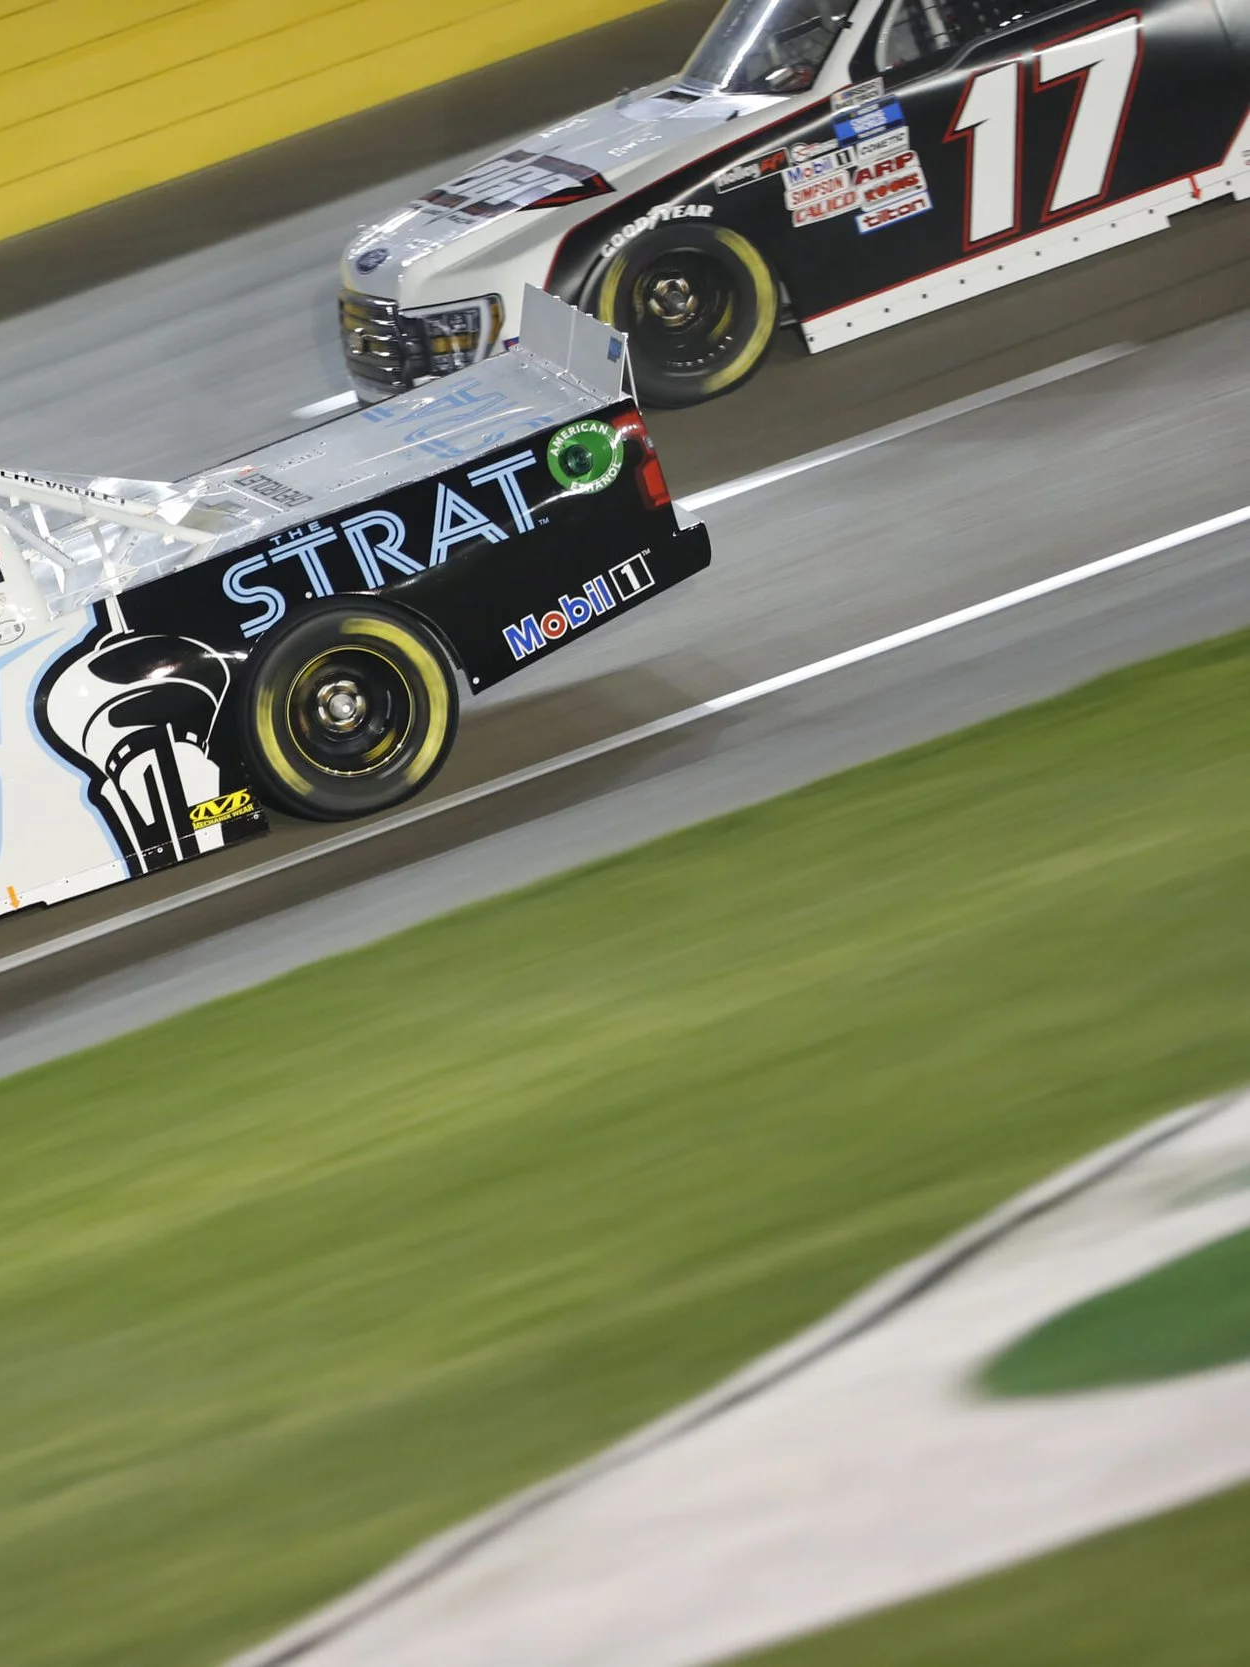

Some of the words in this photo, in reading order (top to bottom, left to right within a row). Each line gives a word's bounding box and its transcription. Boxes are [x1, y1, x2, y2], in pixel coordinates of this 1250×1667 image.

[948, 12, 1141, 247] 17
[855, 151, 914, 185] ARP
[794, 190, 857, 224] CALICO
[601, 203, 713, 257] GOODYEAR
[550, 422, 609, 457] AMERICAN
[222, 449, 537, 639] STRAT
[269, 521, 322, 546] THE
[502, 574, 617, 661] Mobil
[231, 803, 255, 818] WEAR
